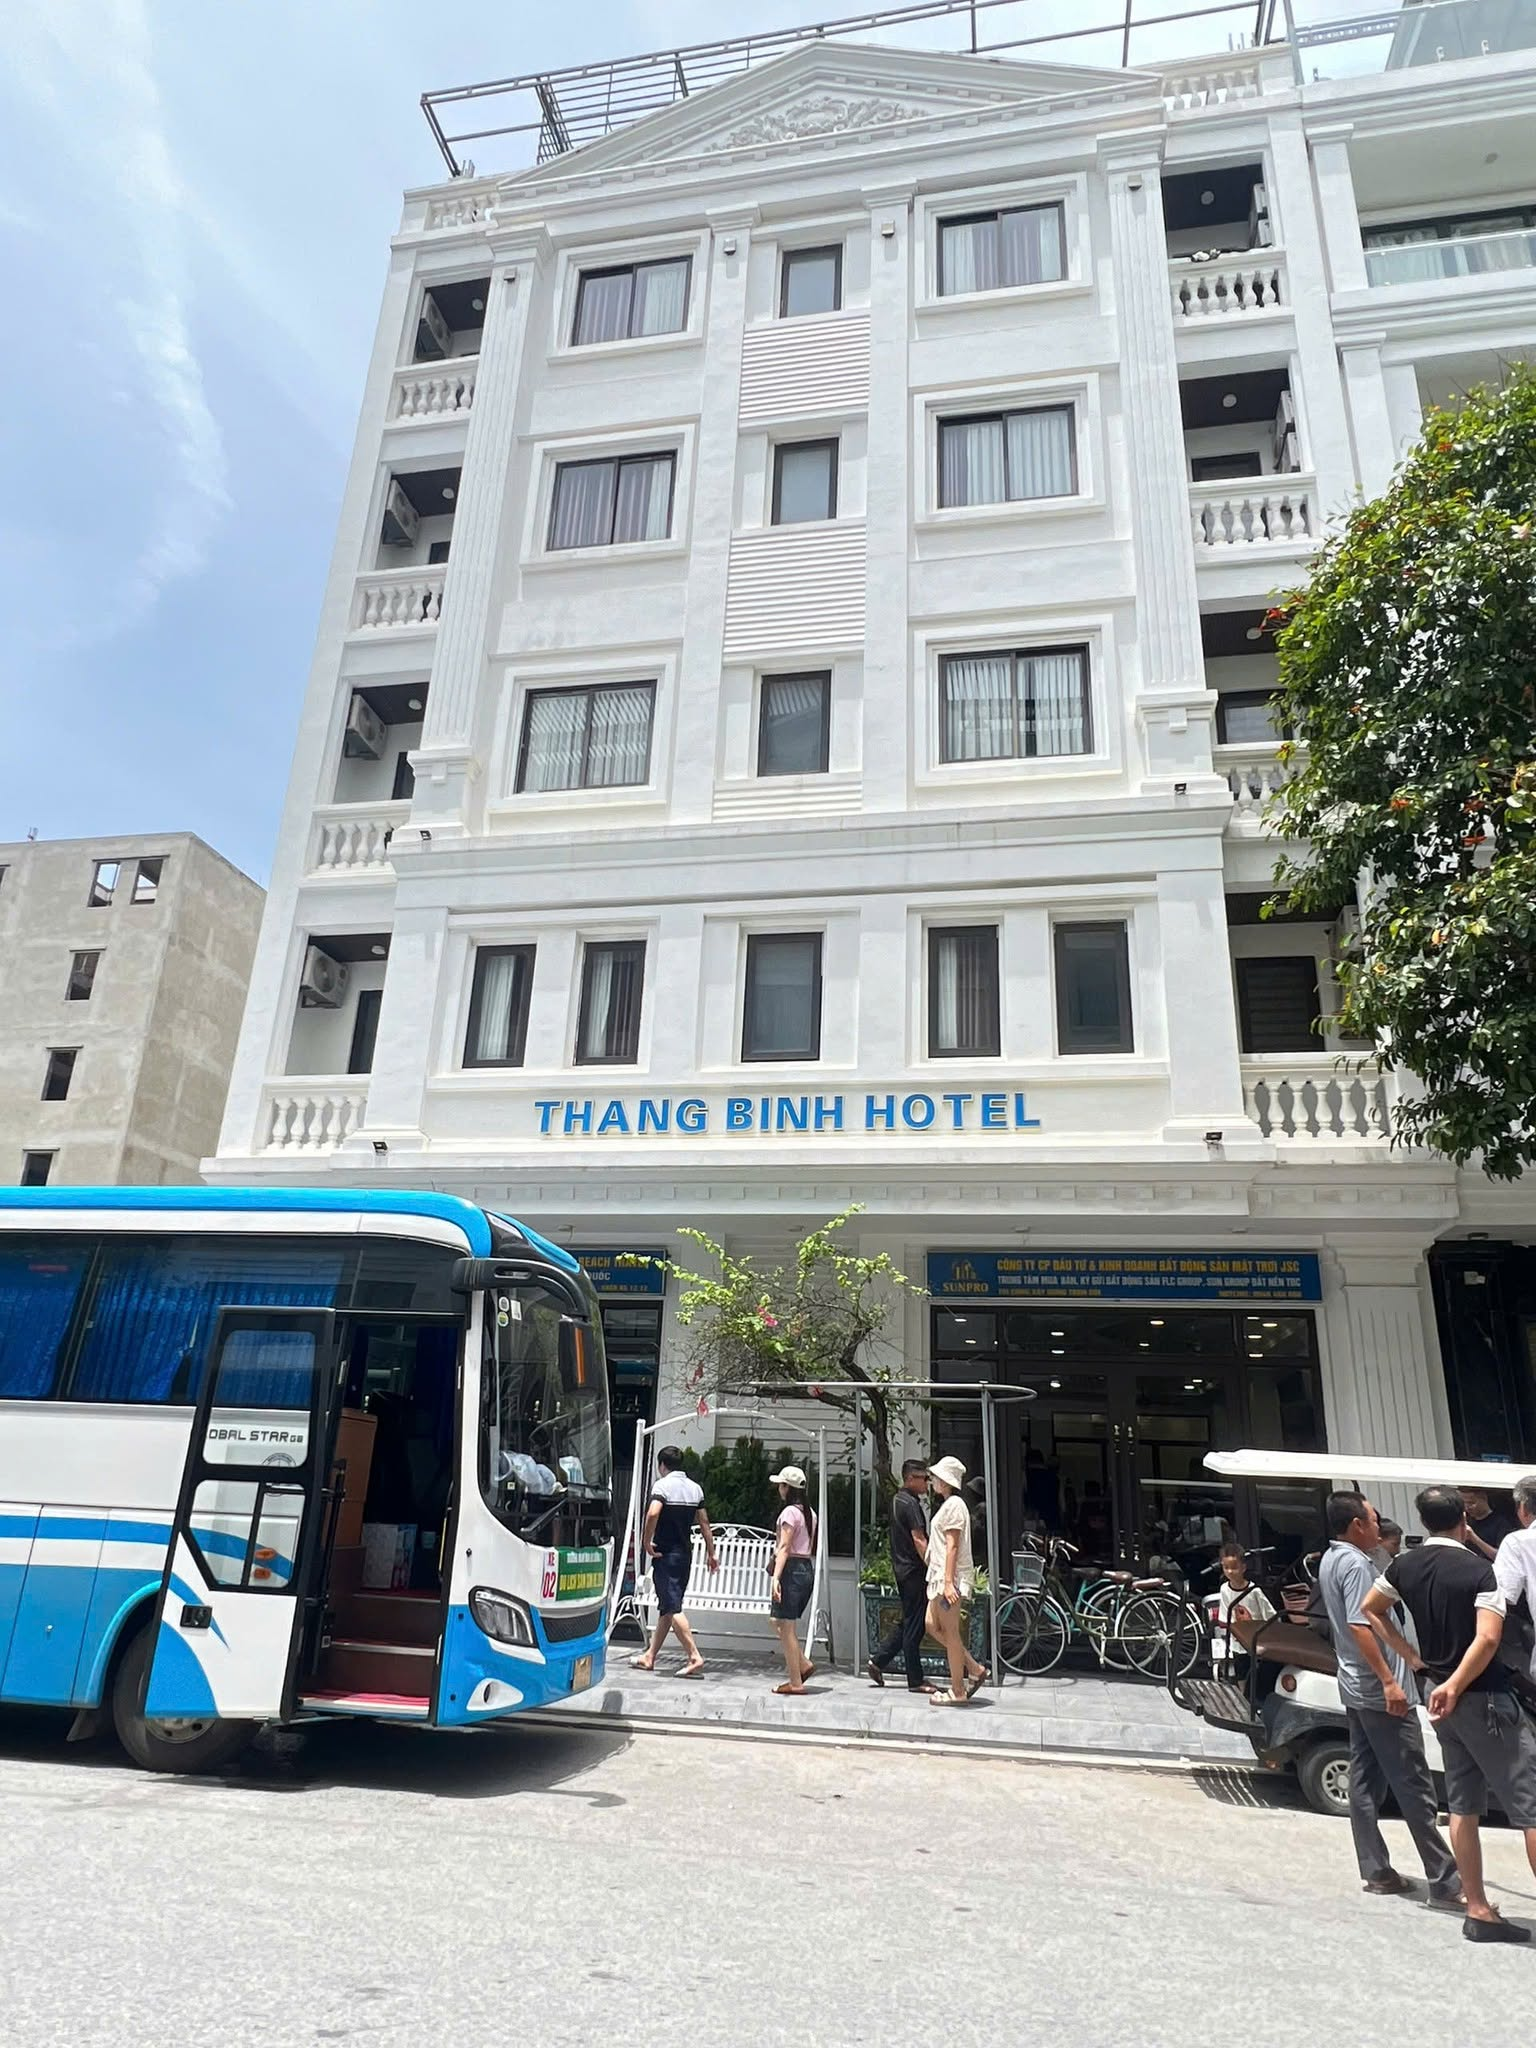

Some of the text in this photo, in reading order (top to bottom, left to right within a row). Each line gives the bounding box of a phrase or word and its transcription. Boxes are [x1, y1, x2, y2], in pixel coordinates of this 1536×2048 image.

[534, 1093, 1042, 1135] THANG BINH HOTEL
[943, 1282, 989, 1293] SUNPRO
[250, 1431, 289, 1443] STAR
[543, 1572, 556, 1598] 02
